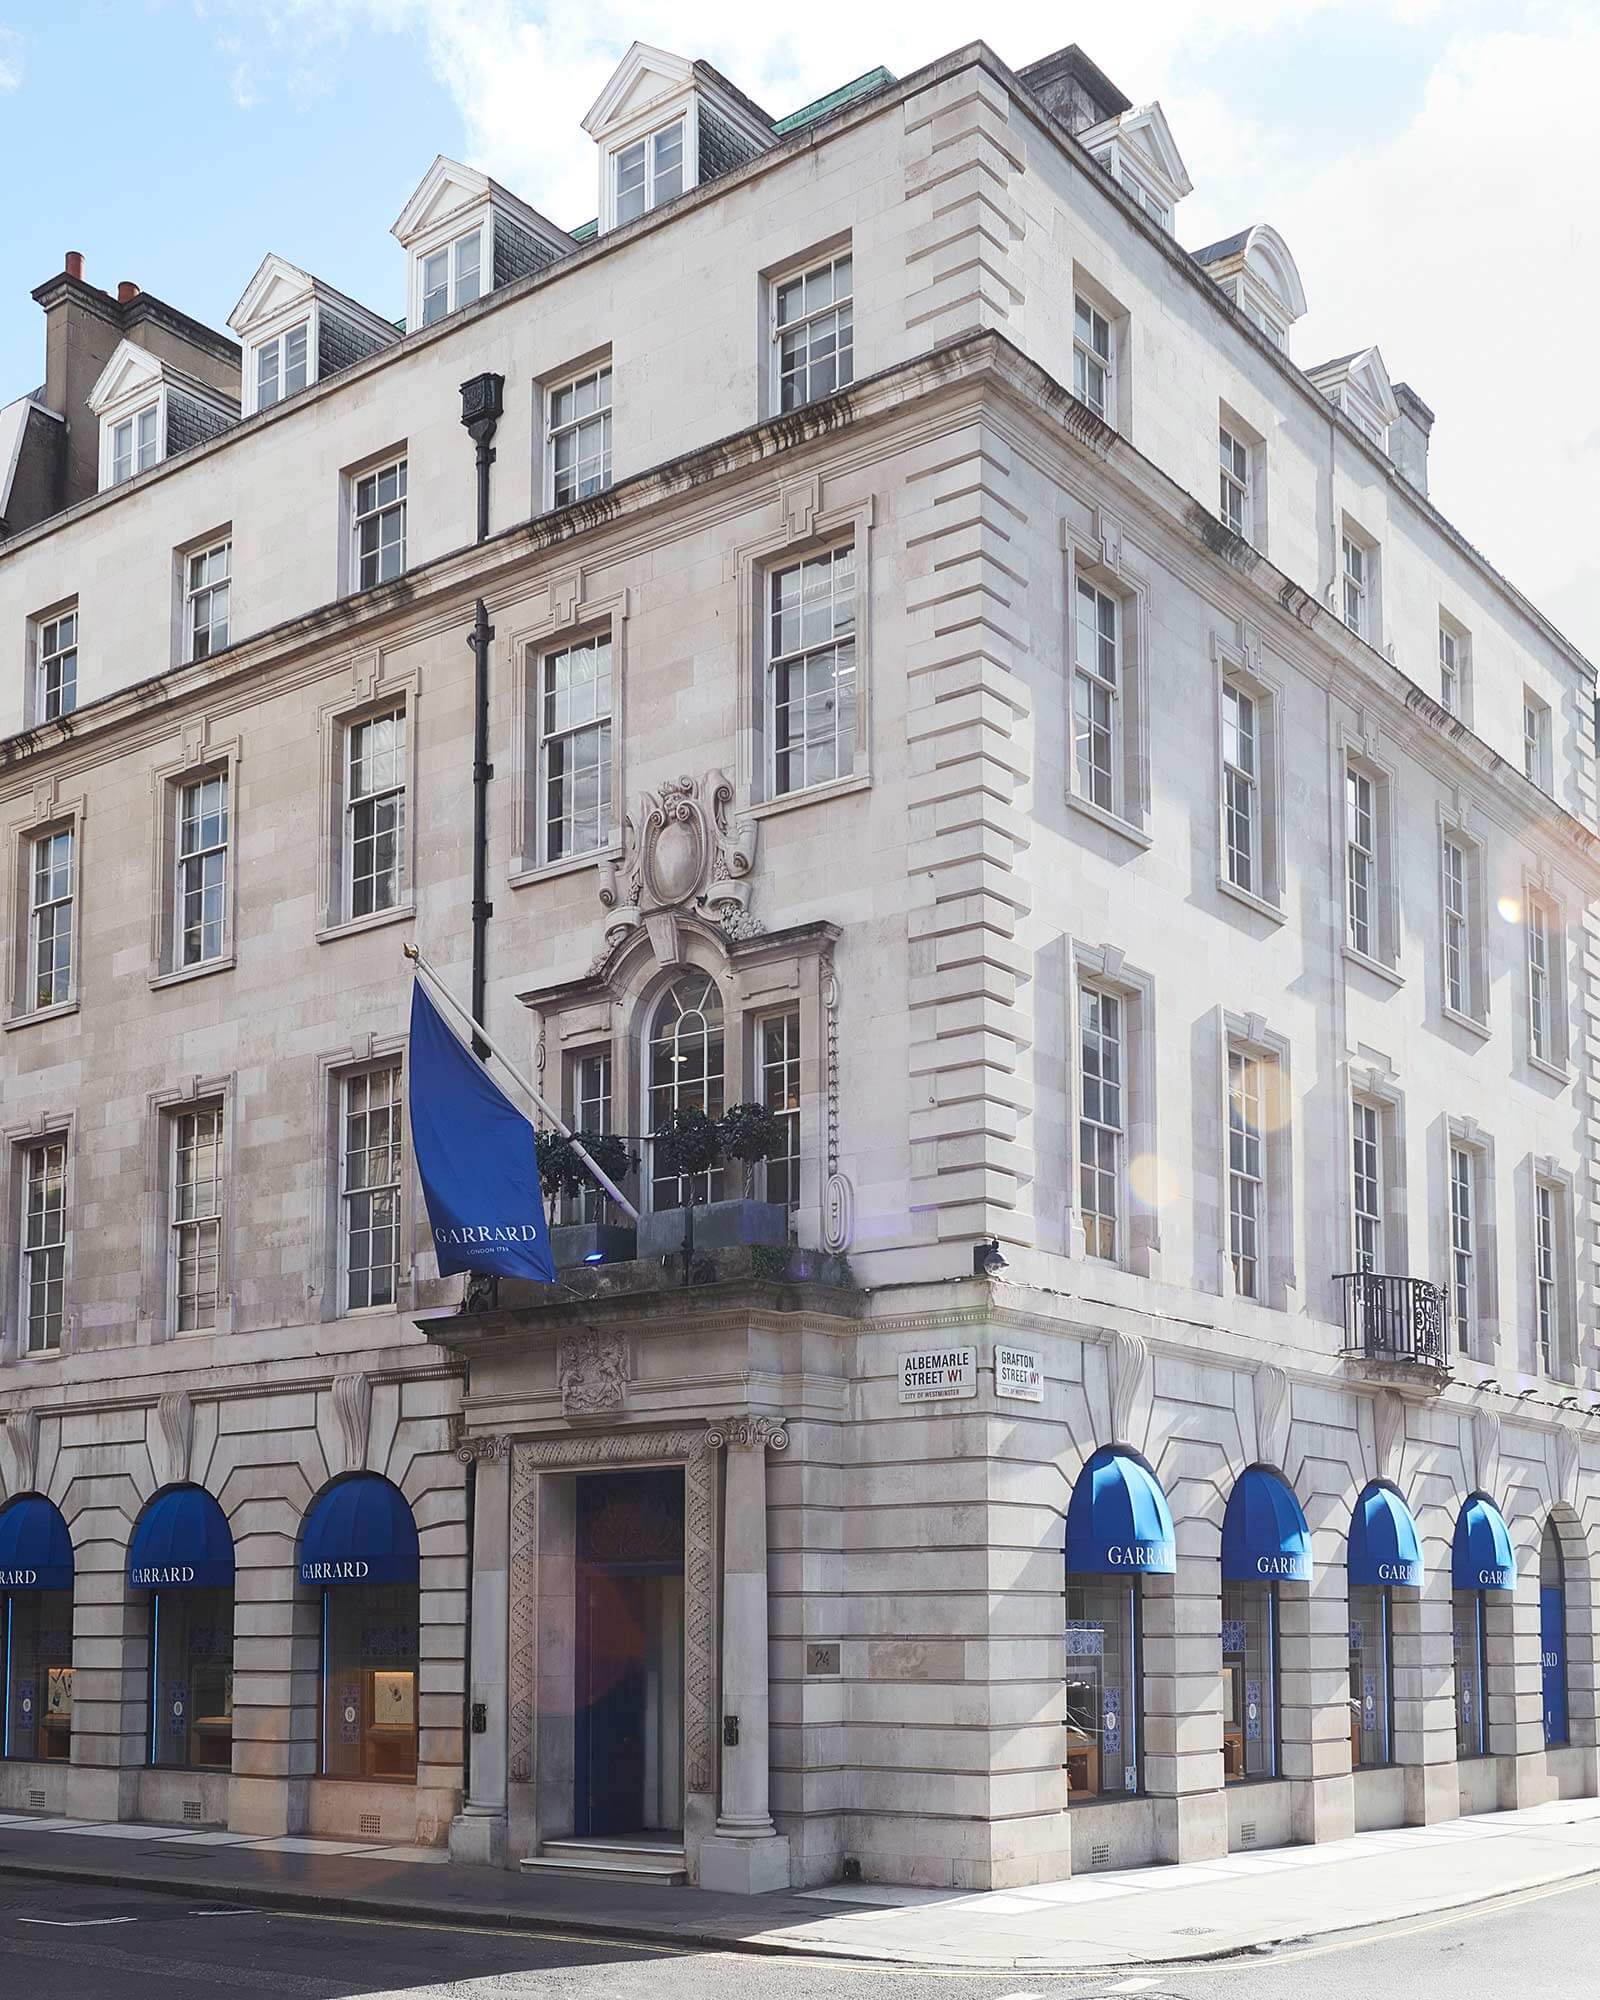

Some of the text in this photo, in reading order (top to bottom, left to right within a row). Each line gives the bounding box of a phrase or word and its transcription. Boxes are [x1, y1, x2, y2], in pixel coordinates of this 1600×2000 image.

[435, 1225, 537, 1243] GARRARD
[467, 1247, 495, 1255] LONDON
[905, 1352, 969, 1371] ALBEMARLE
[1001, 1351, 1034, 1369] GRAFTON
[904, 1369, 962, 1387] STREET W1
[1001, 1367, 1040, 1385] STREET W1
[905, 1391, 916, 1400] CITY
[132, 1566, 194, 1583] GARRARD
[302, 1561, 369, 1579] GARRARD
